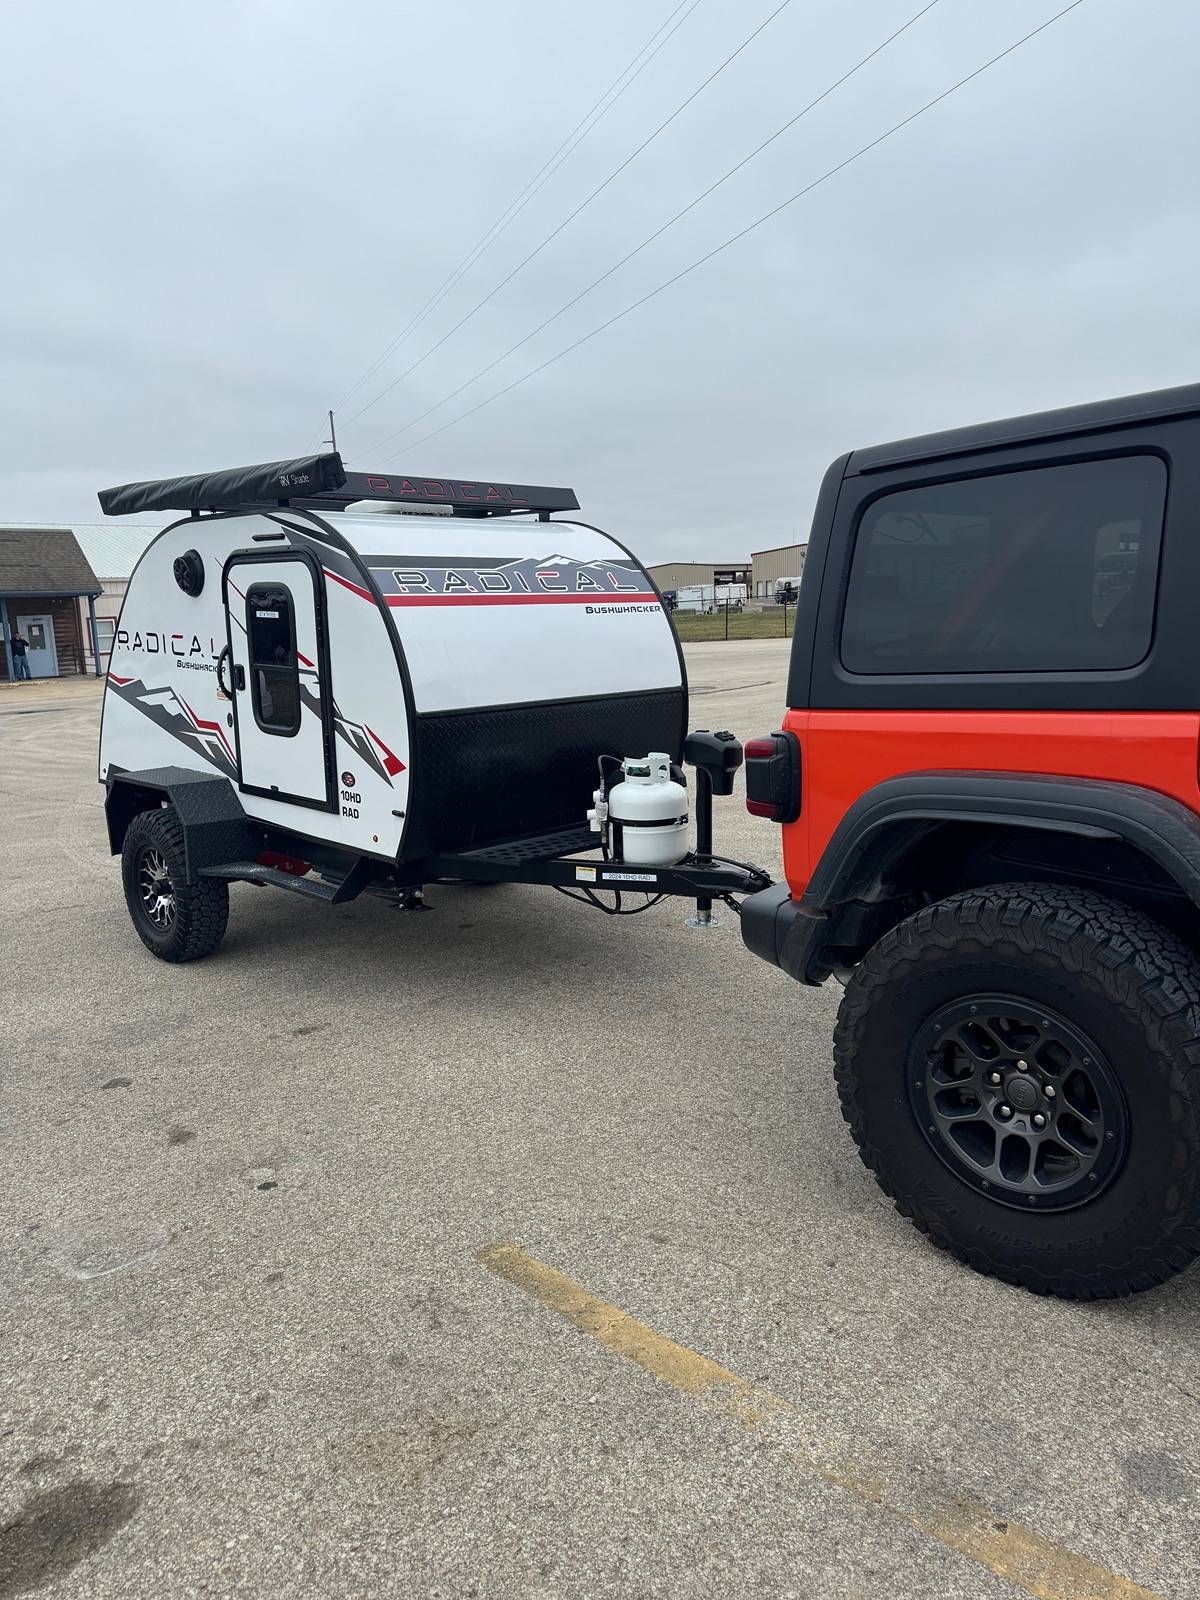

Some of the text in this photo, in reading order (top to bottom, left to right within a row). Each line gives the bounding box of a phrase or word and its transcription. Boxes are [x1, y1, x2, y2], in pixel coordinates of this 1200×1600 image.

[290, 472, 310, 485] Shade
[367, 477, 527, 503] RADICAL
[393, 569, 639, 594] RADICAL
[117, 631, 226, 661] RADICAL
[177, 660, 226, 674] BUSHWHACKR
[341, 790, 361, 803] 10HD
[342, 807, 359, 819] RAD
